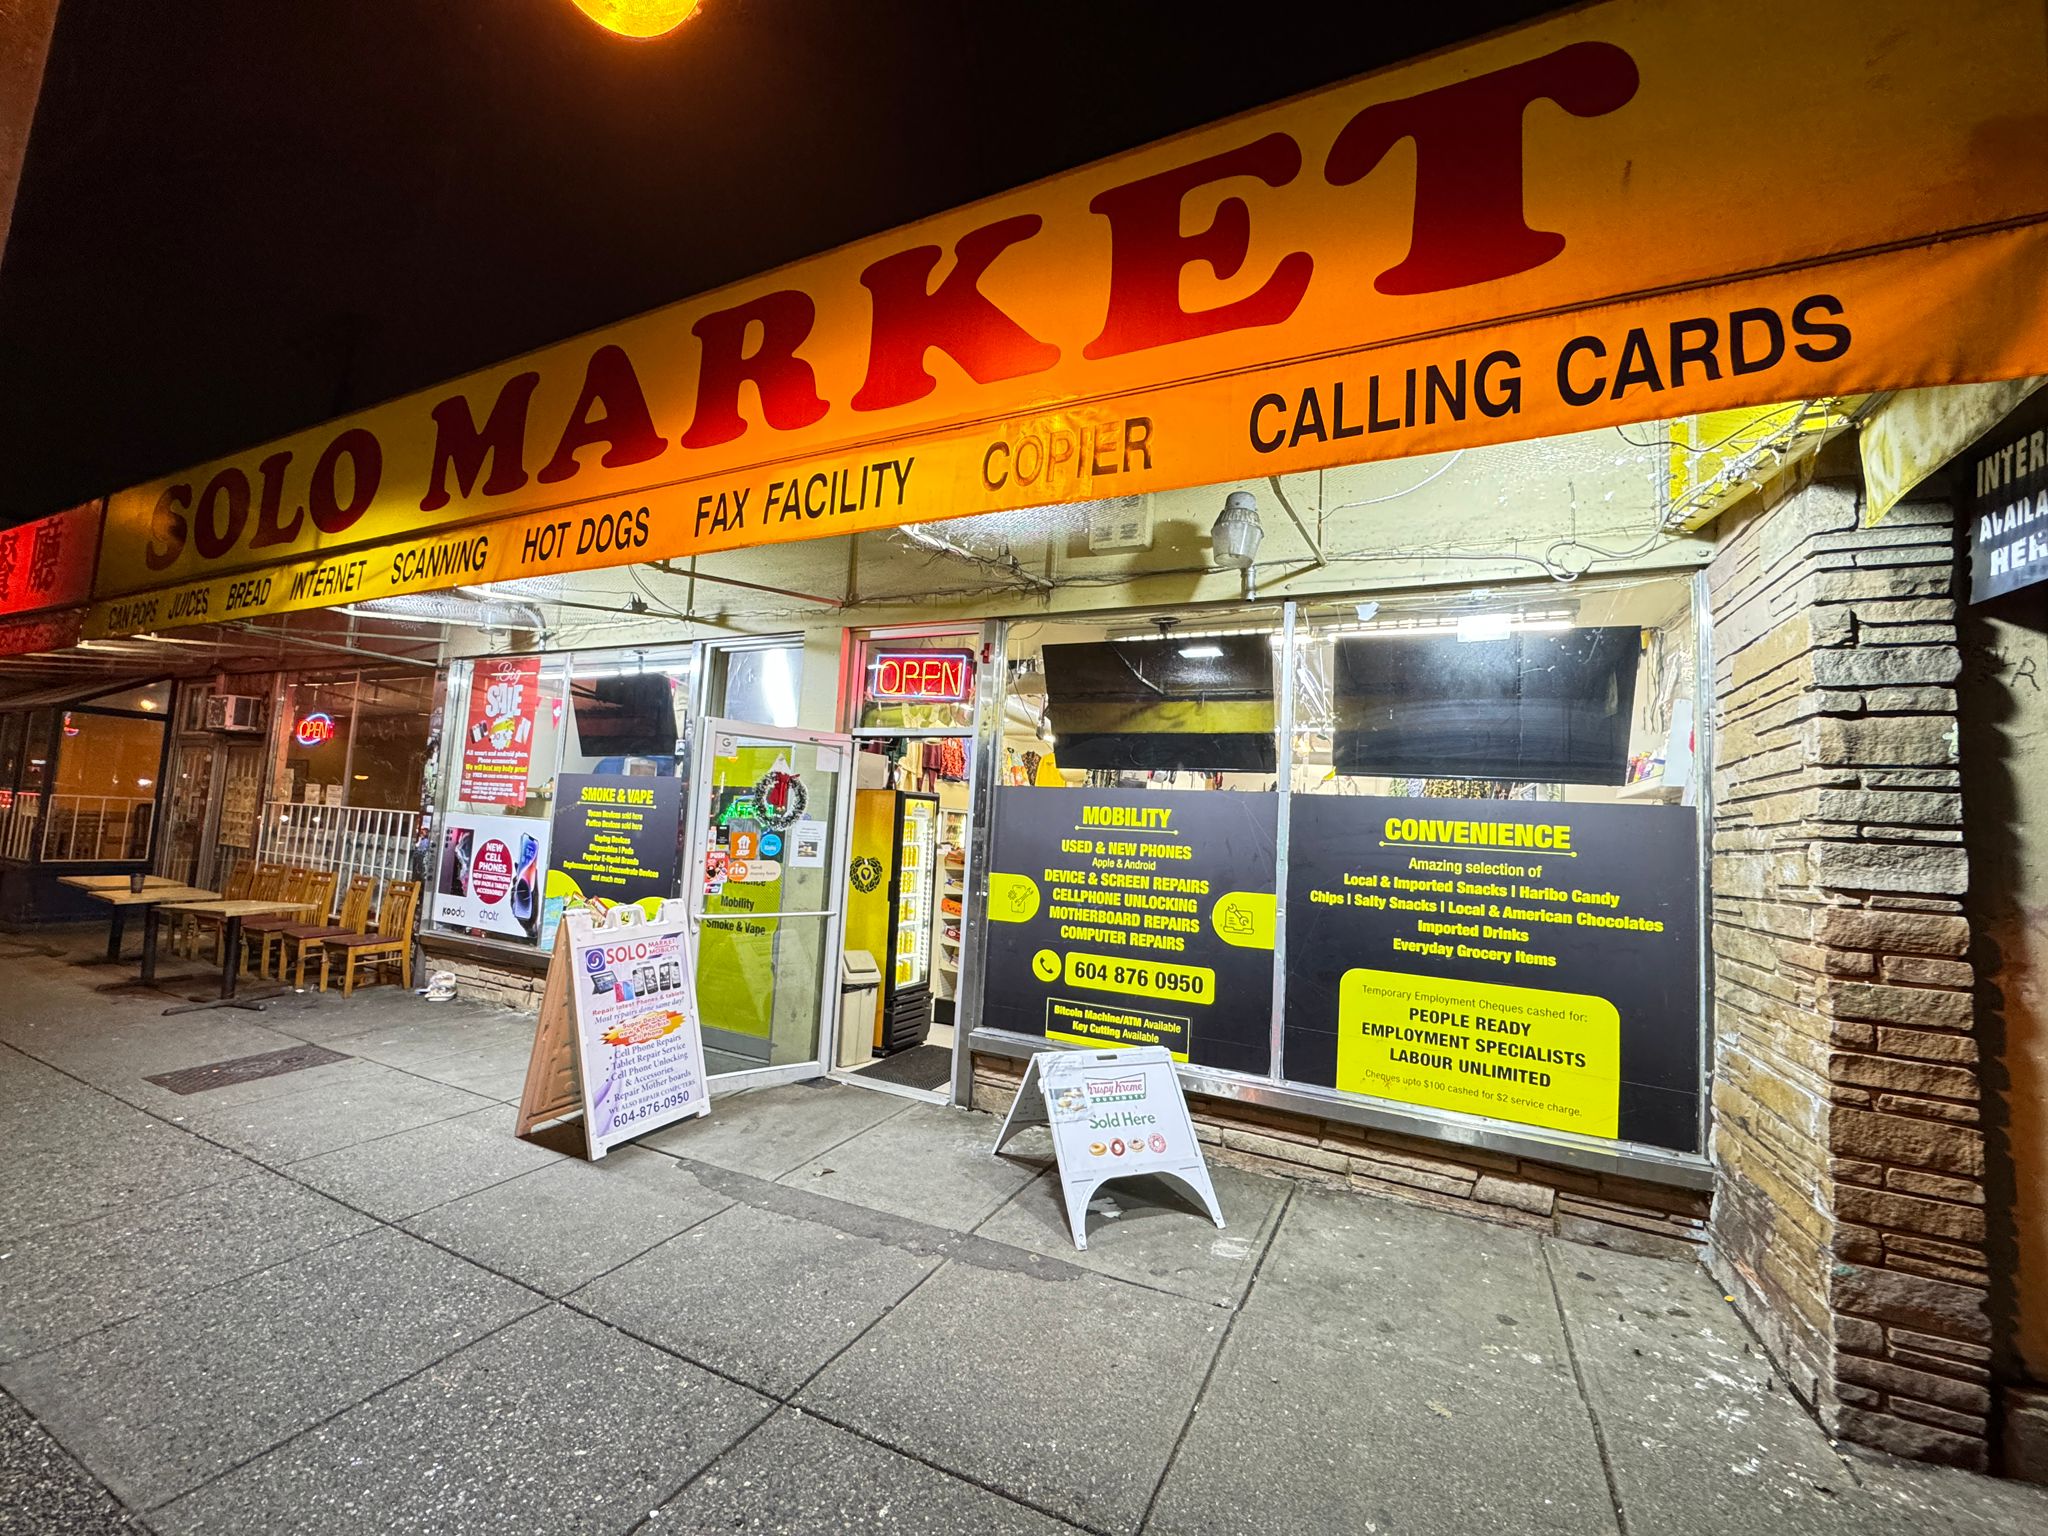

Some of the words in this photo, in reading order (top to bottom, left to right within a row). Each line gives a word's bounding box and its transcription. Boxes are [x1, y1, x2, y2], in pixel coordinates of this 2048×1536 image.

[145, 428, 383, 571] SOLO
[420, 41, 1640, 512] MARKET
[108, 605, 129, 630] CAN
[130, 600, 159, 626] POPS
[168, 587, 210, 620] JUICES
[225, 578, 272, 611] BREAD
[289, 560, 367, 600] INTERNET
[391, 536, 489, 584] SCANNING
[521, 521, 572, 564] HOT
[575, 506, 651, 555] DOGS
[694, 486, 751, 538] FAX
[763, 457, 915, 525] FACILITY
[981, 416, 1153, 493] COPIER
[1249, 350, 1521, 454] CALLING
[1556, 294, 1852, 406] CARDS
[1976, 426, 2048, 497] INTER
[497, 661, 522, 685] Big
[880, 660, 962, 696] OPEN
[485, 683, 524, 717] SALE
[299, 719, 329, 739] OPEN
[582, 787, 616, 802] SMOKE
[617, 788, 625, 803] &
[628, 789, 654, 804] VAPE
[1082, 806, 1172, 828] MOBILITY
[1385, 817, 1571, 849] CONVENIENCE
[485, 852, 502, 862] CELL
[486, 843, 504, 852] NEW
[1062, 839, 1092, 853] USED
[1095, 841, 1106, 854] &
[1108, 842, 1137, 856] NEW
[1140, 843, 1192, 860] PHONES
[479, 862, 507, 873] PHONES
[730, 864, 746, 874] ria
[1092, 857, 1114, 869] Apple
[1116, 859, 1123, 868] &
[1124, 859, 1156, 870] Android
[1408, 857, 1462, 875] Amazing
[1465, 861, 1524, 877] selection
[1528, 865, 1542, 878] of
[1044, 869, 1085, 884] DEVICE
[1088, 872, 1098, 885] &
[1100, 873, 1150, 889] SCREEN
[1153, 877, 1209, 894] REPAIRS
[1344, 873, 1377, 887] Local
[1380, 875, 1390, 888] &
[1394, 877, 1453, 893] Imported
[1457, 881, 1508, 897] Snacks
[1520, 886, 1568, 902] Haribo
[1572, 889, 1620, 908] Candy
[442, 906, 465, 918] koodo
[720, 896, 754, 911] Mobility
[1052, 888, 1121, 906] CELLPHONE
[1124, 894, 1197, 913] UNLOCKING
[1310, 890, 1344, 906] Chips
[1354, 893, 1386, 910] Salty
[1389, 897, 1437, 913] Snacks
[1448, 901, 1485, 916] Local
[1488, 905, 1500, 918] &
[1502, 906, 1572, 924] American
[1576, 912, 1664, 932] Chocolates
[706, 918, 734, 932] Smoke
[736, 922, 743, 932] &
[745, 922, 766, 936] Vape
[1049, 906, 1140, 927] MOTHERBOARD
[1144, 914, 1200, 933] REPAIRS
[1418, 920, 1479, 937] Imported
[1482, 925, 1529, 942] Drinks
[648, 939, 675, 948] MARKET
[649, 945, 680, 955] MOBILITY
[1060, 925, 1126, 944] COMPUTER
[1130, 932, 1185, 951] REPAIRS
[606, 943, 647, 964] SOLO
[1393, 938, 1453, 957] Everyday
[1457, 944, 1512, 964] Grocery
[1515, 950, 1557, 967] Items
[1075, 962, 1107, 981] 604
[1114, 966, 1148, 987] 876
[1155, 972, 1203, 994] 0950
[592, 1008, 614, 1016] Repair
[636, 997, 658, 1006] Phones
[594, 1015, 612, 1025] Most
[614, 1010, 638, 1021] repairs
[639, 1005, 654, 1013] done
[656, 1001, 670, 1009] same
[1362, 985, 1411, 1000] Temporary
[1414, 991, 1475, 1007] Employment
[1479, 999, 1523, 1014] Cheques
[1526, 1007, 1565, 1020] cashed
[1569, 1011, 1588, 1022] for:
[1054, 1005, 1083, 1018] Bitcoin
[1084, 1009, 1142, 1027] Machine/ATM
[1143, 1018, 1181, 1034] Available
[1410, 1008, 1470, 1028] PEOPLE
[1476, 1016, 1531, 1036] READY
[1072, 1021, 1088, 1033] Key
[1089, 1023, 1121, 1039] Cutting
[1122, 1028, 1160, 1044] Available
[1362, 1022, 1470, 1050] EMPLOYMENT
[1475, 1039, 1586, 1068] SPECIALISTS
[612, 1058, 635, 1070] Tablet
[637, 1051, 660, 1062] Repair
[662, 1044, 686, 1054] Service
[615, 1049, 630, 1059] Cell
[632, 1043, 655, 1054] Phone
[657, 1035, 681, 1047] Repairs
[611, 1070, 626, 1081] Cell
[629, 1063, 652, 1076] Phone
[654, 1052, 688, 1067] Unlocking
[626, 1079, 632, 1087] &
[634, 1067, 673, 1084] Accessories
[1390, 1048, 1452, 1070] LABOUR
[1459, 1059, 1551, 1087] UNLIMITED
[614, 1088, 640, 1102] Repair
[641, 1078, 667, 1093] Mother
[669, 1069, 691, 1083] boards
[621, 1100, 637, 1110] ALSO
[639, 1092, 660, 1104] REPAIR
[660, 1080, 695, 1096] COMPUTERS
[1365, 1069, 1400, 1083] Cheques
[1402, 1076, 1421, 1086] upto
[1424, 1079, 1445, 1090] $100
[1447, 1085, 1479, 1097] cashed
[1482, 1090, 1494, 1100] for
[1496, 1092, 1508, 1103] $2
[1510, 1096, 1544, 1110] service
[613, 1090, 690, 1127] 604-876-0950
[1089, 1112, 1120, 1129] Sold
[1122, 1111, 1156, 1126] Here
